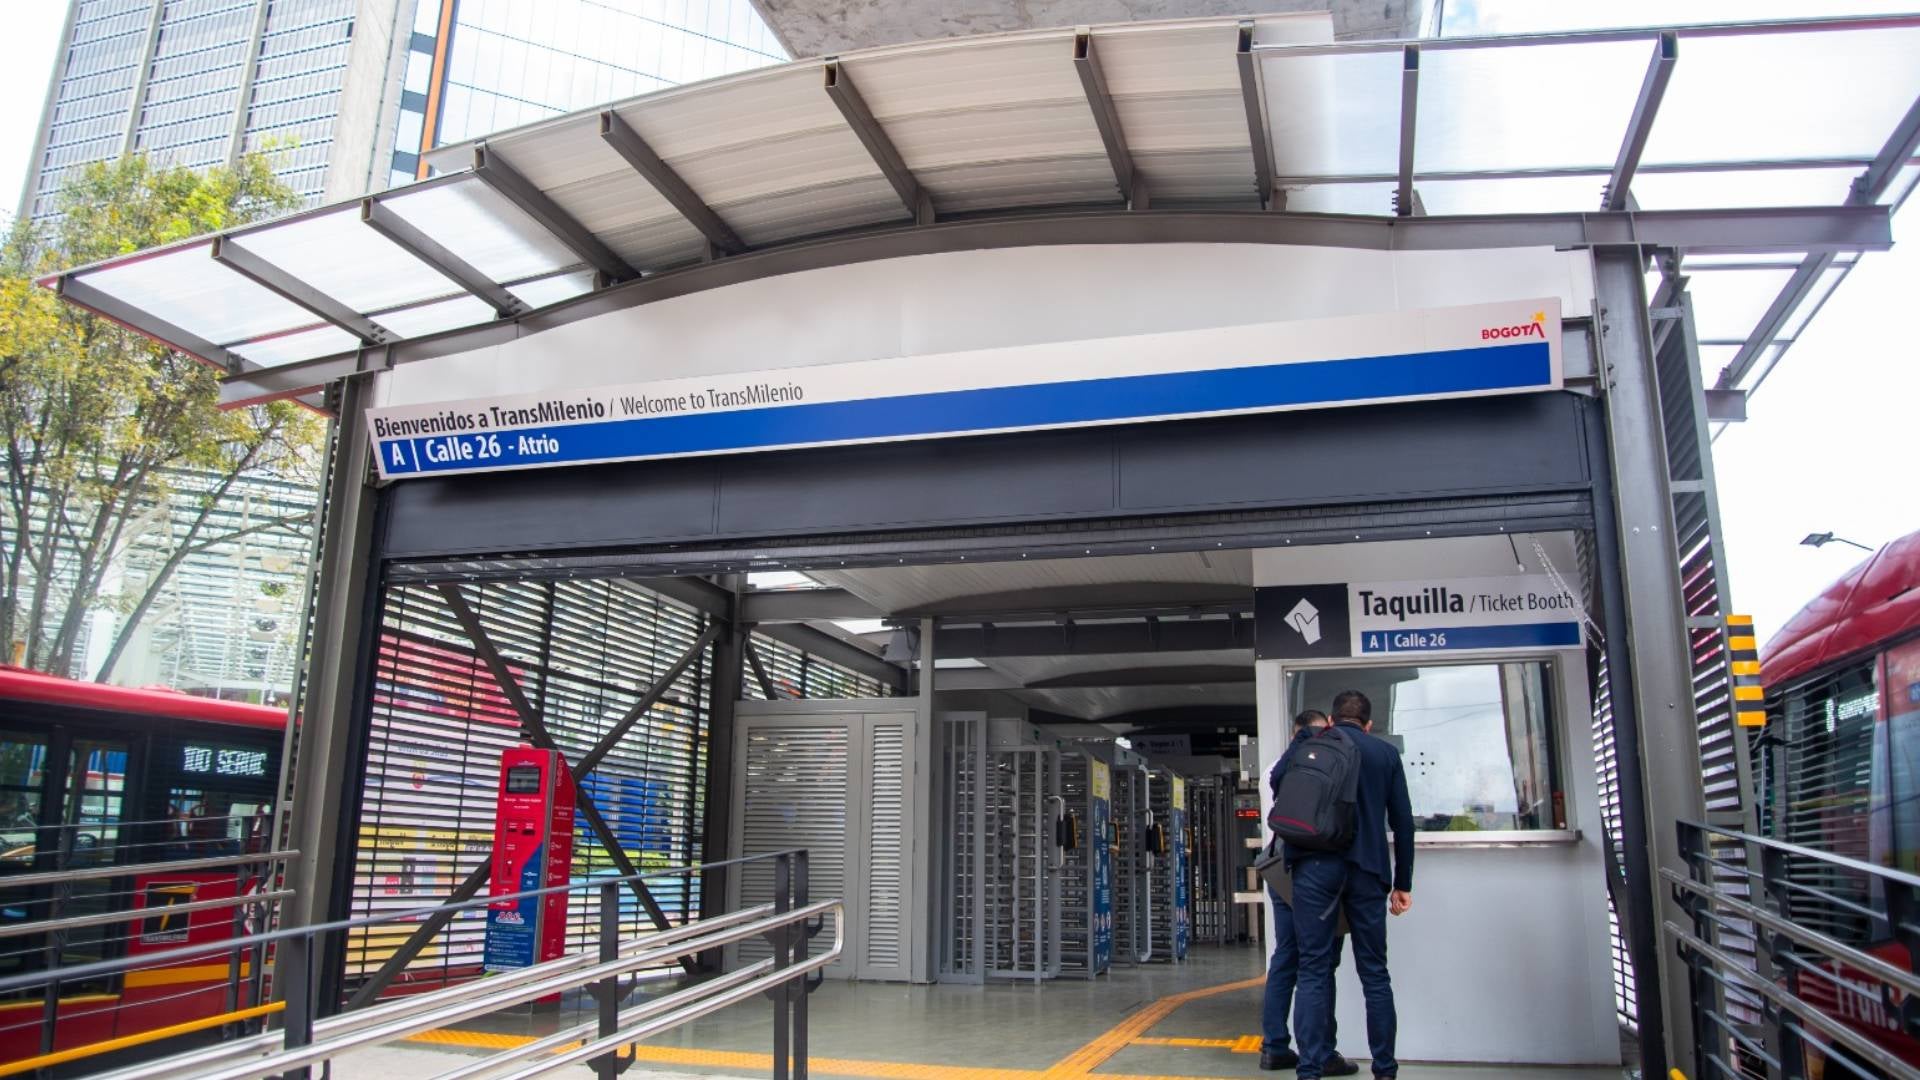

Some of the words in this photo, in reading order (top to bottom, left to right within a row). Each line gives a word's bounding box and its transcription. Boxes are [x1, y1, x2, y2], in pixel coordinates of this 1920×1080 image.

[374, 408, 475, 438] Bienvenidos
[478, 413, 489, 428] a
[490, 397, 605, 427] TransMilenio
[620, 394, 687, 416] Welcome
[689, 393, 705, 410] to
[706, 381, 804, 408] TransMilenio
[392, 442, 406, 467] A
[425, 437, 473, 463] Calle
[475, 434, 501, 459] 26
[518, 434, 560, 456] Atrio
[1358, 587, 1464, 622] Taquilla
[1478, 593, 1524, 613] Ticket
[1369, 635, 1379, 649] A
[1394, 633, 1427, 649] Calle
[1430, 633, 1446, 648] 26
